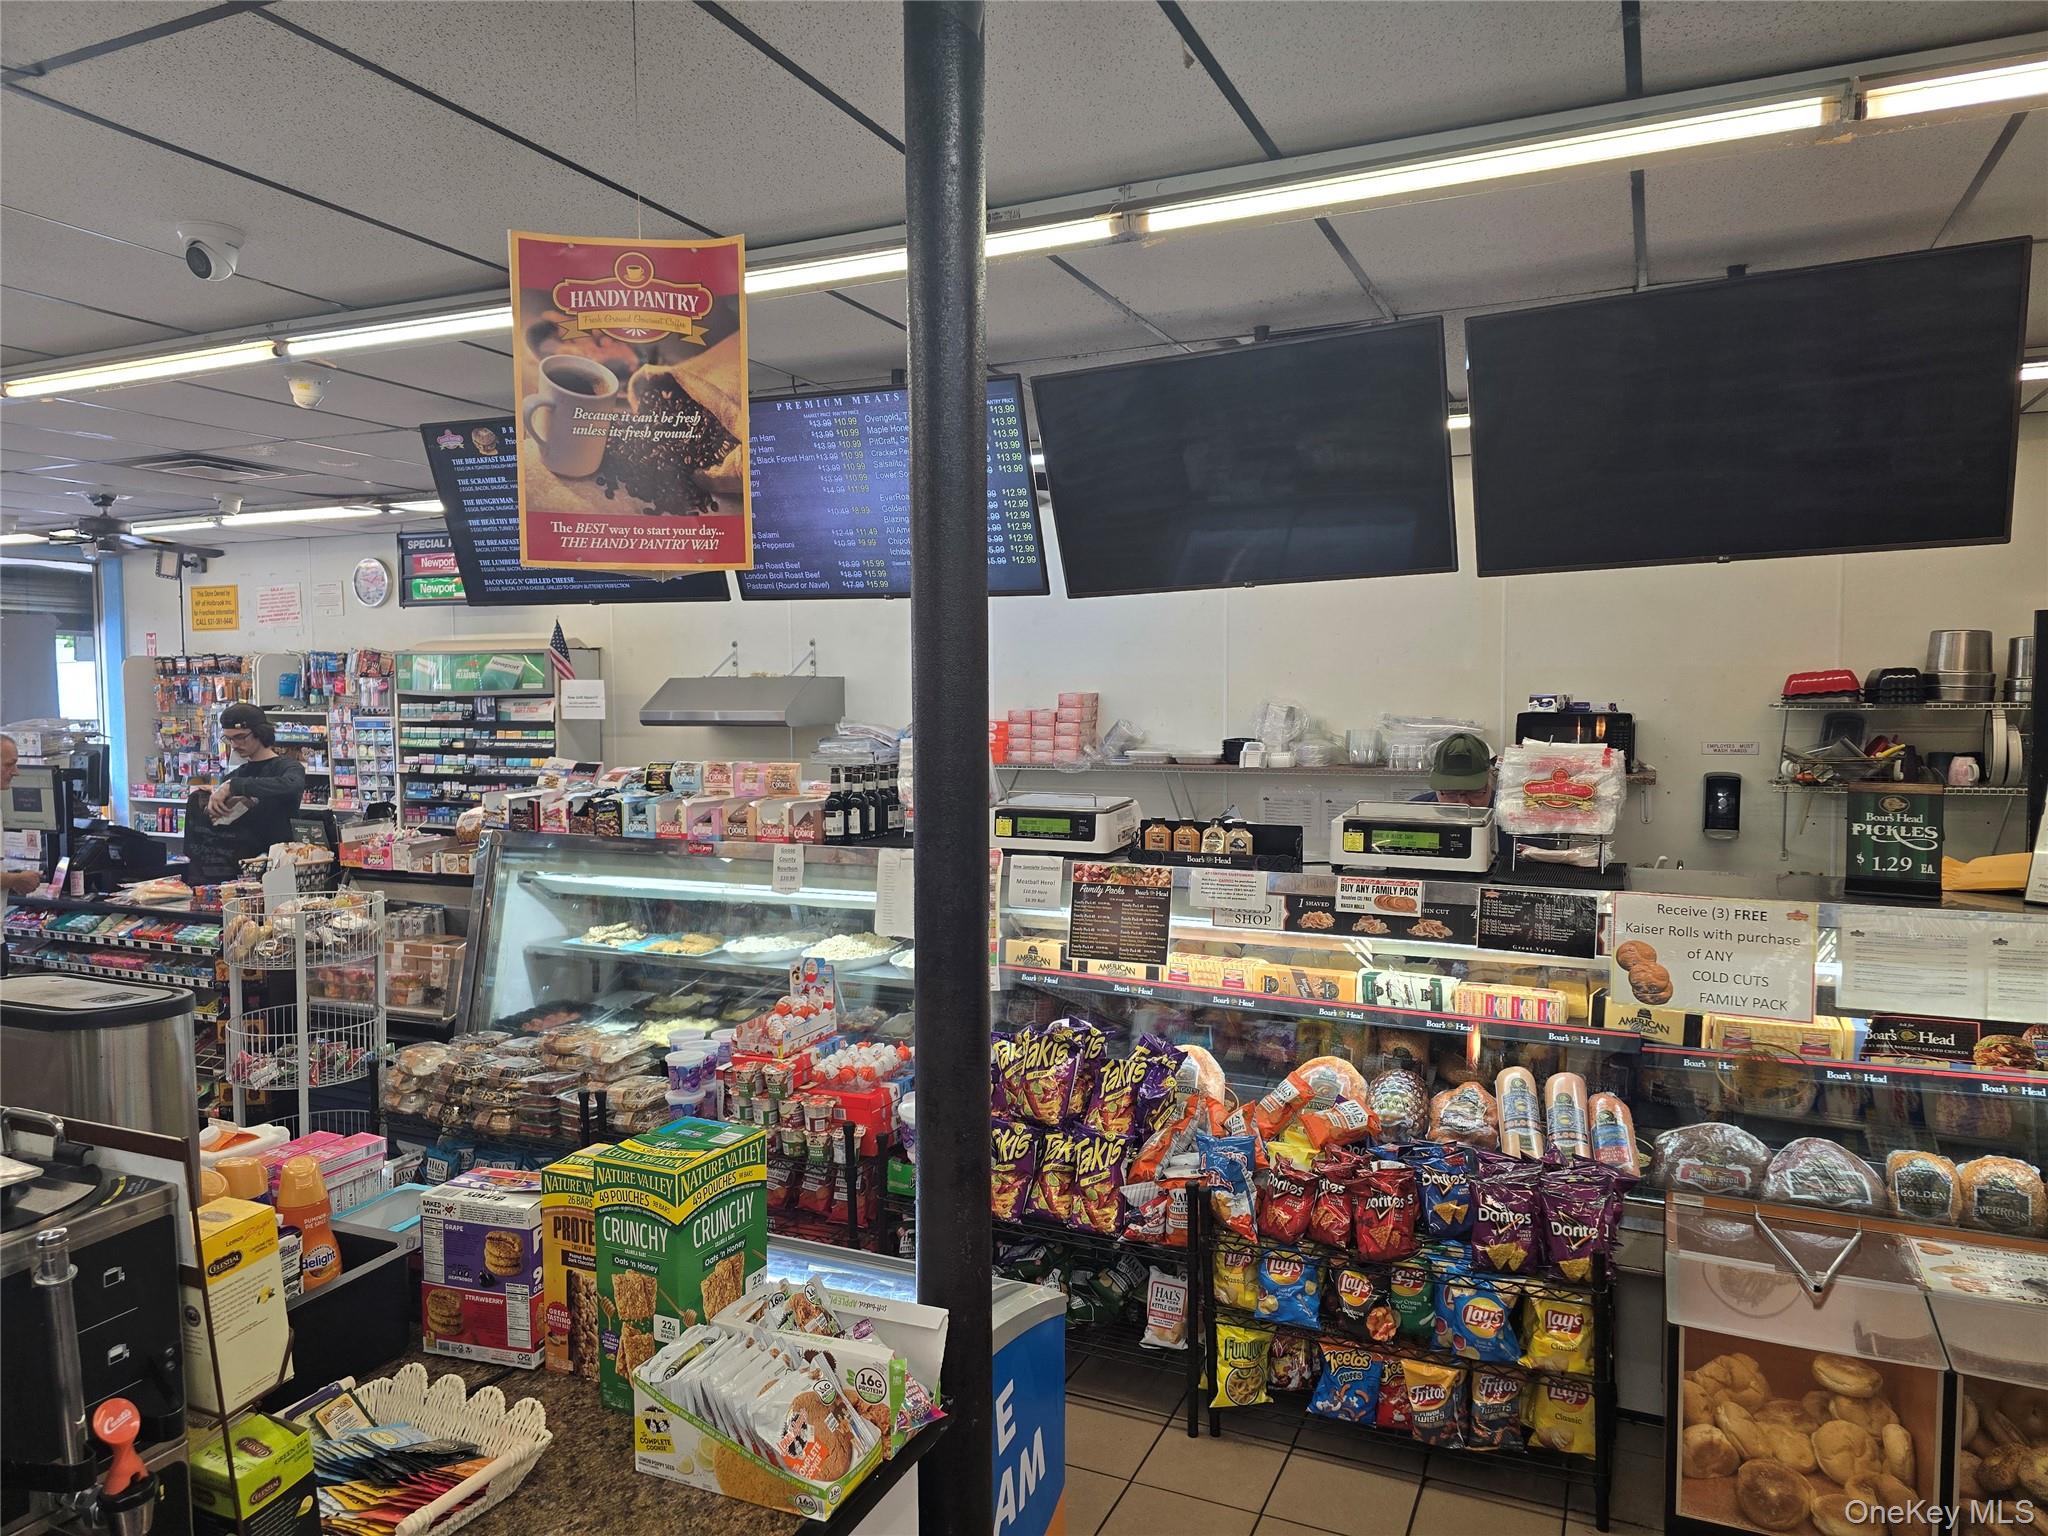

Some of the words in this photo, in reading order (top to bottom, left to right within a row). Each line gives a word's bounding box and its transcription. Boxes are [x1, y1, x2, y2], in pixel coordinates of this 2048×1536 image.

[570, 289, 631, 308] HANDY
[634, 289, 699, 312] PANTRY
[776, 398, 842, 411] PREMIUM
[852, 392, 900, 405] MEATS
[573, 407, 618, 420] Because
[621, 411, 630, 421] it
[632, 410, 658, 423] can't
[661, 411, 673, 423] be
[672, 411, 701, 426] fresh
[572, 423, 606, 435] unless
[609, 425, 622, 436] its
[621, 426, 651, 440] fresh
[867, 425, 889, 434] Maple
[759, 434, 776, 442] Ham
[838, 440, 861, 448] $10.99
[995, 440, 1020, 450] $13.99
[757, 455, 775, 464] Black
[776, 455, 798, 463] Forest
[800, 453, 815, 462] Ham
[871, 448, 898, 457] Cracked
[997, 452, 1022, 462] $13.99
[465, 456, 498, 465] BREAKFAST
[875, 470, 895, 479] Lower
[998, 464, 1024, 473] $13.99
[881, 505, 907, 513] Golden
[883, 516, 909, 524] Blazing
[550, 521, 572, 533] The
[576, 523, 608, 534] BEST
[608, 526, 631, 538] way
[634, 525, 644, 535] to
[647, 525, 670, 536] start
[672, 527, 698, 538] your
[699, 524, 725, 538] day...
[757, 531, 779, 539] Salami
[407, 538, 445, 550] SPECIAL
[560, 537, 588, 548] THE
[591, 537, 638, 550] HANDY
[639, 539, 689, 550] PANTRY
[692, 539, 719, 550] WAY!
[1008, 533, 1033, 542] $12.99
[762, 541, 794, 550] Pepperoni
[1010, 544, 1035, 553] $12.99
[421, 557, 455, 568] Newport
[766, 562, 784, 570] Roast
[785, 561, 800, 569] Beef
[1012, 556, 1037, 565] $12.99
[744, 572, 768, 581] London
[769, 571, 784, 580] Broil
[785, 571, 804, 579] Roast
[805, 570, 820, 579] Beef
[864, 569, 887, 578] $15.99
[420, 583, 456, 594] Newport
[746, 581, 775, 590] Pastrami
[776, 581, 799, 590] (Round
[808, 581, 830, 590] Navel)
[866, 580, 889, 588] $15.99
[1851, 823, 1939, 848] PICKLES
[1856, 853, 1864, 865] $
[1872, 855, 1913, 872] 1.29
[1920, 864, 1936, 874] EA.
[1080, 884, 1103, 897] Family
[1104, 885, 1125, 895] Packs
[1341, 883, 1353, 893] BUY
[1356, 885, 1369, 894] ANY
[1371, 885, 1397, 895] FAMILY
[1400, 886, 1419, 897] PACK
[1305, 900, 1329, 908] SHAVED
[1657, 903, 1707, 918] Receive
[1711, 907, 1730, 921] (3)
[1734, 909, 1768, 921] FREE
[1235, 914, 1272, 926] SHOP
[1625, 922, 1664, 936] Kaiser
[1668, 925, 1699, 938] Rolls
[1703, 928, 1733, 941] with
[1737, 932, 1801, 947] purchase
[1687, 949, 1701, 960] of
[1704, 950, 1734, 962] ANY
[1692, 970, 1729, 984] COLD
[1733, 973, 1769, 987] CUTS
[1700, 992, 1749, 1007] FAMILY
[1752, 997, 1788, 1012] PACK
[1618, 1016, 1670, 1035] AMERICAN
[1580, 1035, 1600, 1045] Head
[1864, 1028, 1897, 1041] Boar's
[1918, 1031, 1955, 1046] Head
[1683, 1058, 1706, 1068] Boar's
[1826, 1070, 1852, 1081] Boar's
[1863, 1074, 1888, 1084] Head
[1982, 1083, 2008, 1094] Boar's
[2021, 1086, 2047, 1097] Head
[1074, 1137, 1126, 1182] Takis
[680, 1159, 724, 1200] NATURE
[725, 1138, 764, 1169] VALLEY
[543, 1174, 581, 1193] NATURE
[596, 1166, 635, 1187] NATURE
[636, 1172, 674, 1200] VALLEY
[692, 1192, 703, 1207] 49
[702, 1172, 737, 1199] POUCHES
[1900, 1189, 1946, 1200] GOLDEN
[423, 1200, 441, 1208] BAKED
[568, 1195, 575, 1204] 26
[575, 1196, 593, 1208] BARS
[599, 1192, 609, 1204] 49
[609, 1190, 650, 1207] POUCHES
[659, 1203, 671, 1215] BARS
[423, 1207, 441, 1215] WITH
[1478, 1207, 1532, 1224] Doritos
[303, 1214, 327, 1225] PUMPKIN
[304, 1222, 314, 1230] PIE
[693, 1192, 754, 1248] CRUNCHY
[445, 1223, 464, 1232] GRAPE
[602, 1215, 668, 1253] CRUNCHY
[225, 1234, 244, 1248] Lemon
[302, 1248, 336, 1271] delight
[569, 1252, 581, 1260] Peanut
[704, 1253, 719, 1267] Oats
[726, 1239, 746, 1255] Honey
[207, 1253, 241, 1275] CELESTIAL
[614, 1256, 628, 1265] Oats
[629, 1258, 636, 1267] 'n
[637, 1261, 658, 1274] Honey
[1340, 1274, 1372, 1297] Lay's
[465, 1294, 504, 1305] STRAWBERRY
[1155, 1286, 1181, 1300] HAL'S
[546, 1312, 571, 1325] TASTING
[549, 1307, 568, 1317] GREAT
[1464, 1304, 1503, 1330] Lay's
[661, 1320, 676, 1331] 22g
[1546, 1310, 1583, 1331] Lay's
[859, 1374, 883, 1389] 16G
[857, 1385, 886, 1396] PROTEIN
[1410, 1386, 1446, 1403] Fritos
[334, 1412, 350, 1426] Lemon
[1554, 1413, 1583, 1424] Classic
[639, 1436, 672, 1446] COMPLETE
[646, 1443, 667, 1451] COOKIE
[274, 1447, 295, 1465] GREEN
[294, 1438, 308, 1451] TEA
[250, 1477, 281, 1505] CELESTIAL
